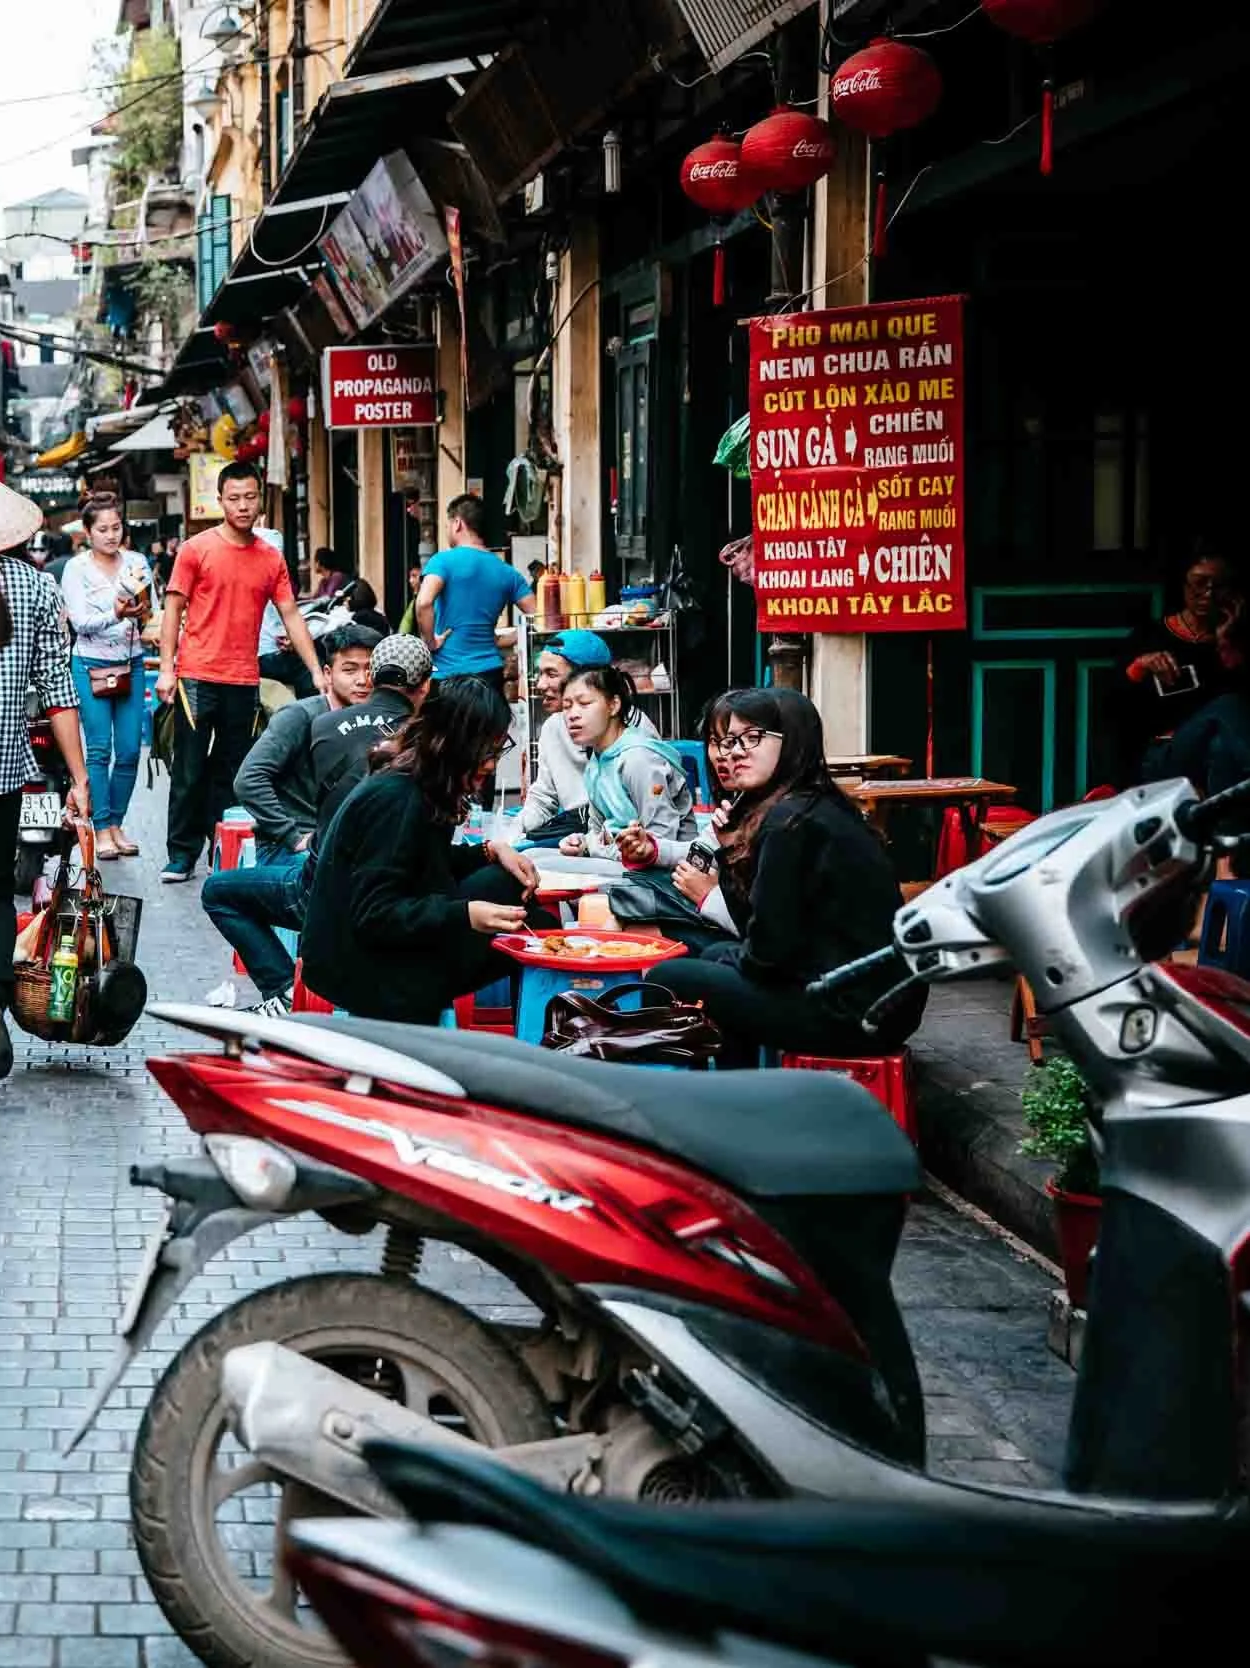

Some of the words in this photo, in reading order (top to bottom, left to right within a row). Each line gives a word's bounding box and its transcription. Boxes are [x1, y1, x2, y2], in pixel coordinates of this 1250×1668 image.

[690, 160, 739, 182] Coca-Cola
[830, 319, 878, 343] MAI
[888, 313, 937, 339] QUE
[367, 353, 398, 371] OLD
[760, 356, 815, 381] NEM
[823, 350, 890, 375] CHUA
[899, 341, 952, 369] RÁN
[333, 377, 432, 398] PROPAGANDA
[764, 387, 806, 414] CÚT
[814, 383, 856, 413] LỘN
[863, 378, 910, 405] XÀO
[919, 378, 955, 401] ME
[354, 401, 413, 421] POSTER
[869, 407, 943, 435] CHIÊN
[756, 427, 800, 478] SỤN
[806, 413, 838, 466] GÀ
[864, 445, 908, 469] RANG
[912, 435, 954, 465] MUỐI
[877, 472, 913, 498] SỐT
[918, 475, 955, 496] CAY
[757, 480, 796, 532] CHÂN
[801, 479, 840, 530] CÁNH
[844, 475, 865, 528] GÀ
[878, 509, 916, 531] RANG
[920, 500, 956, 528] MUỐI
[764, 541, 813, 561] KHOAI
[816, 536, 847, 559] TÂY
[874, 532, 952, 583] CHIÊN
[758, 569, 806, 589] KHOAI
[811, 568, 855, 588] LANG
[766, 597, 839, 616] KHOAI
[846, 592, 894, 615] TÂY
[902, 588, 953, 614] LẮC
